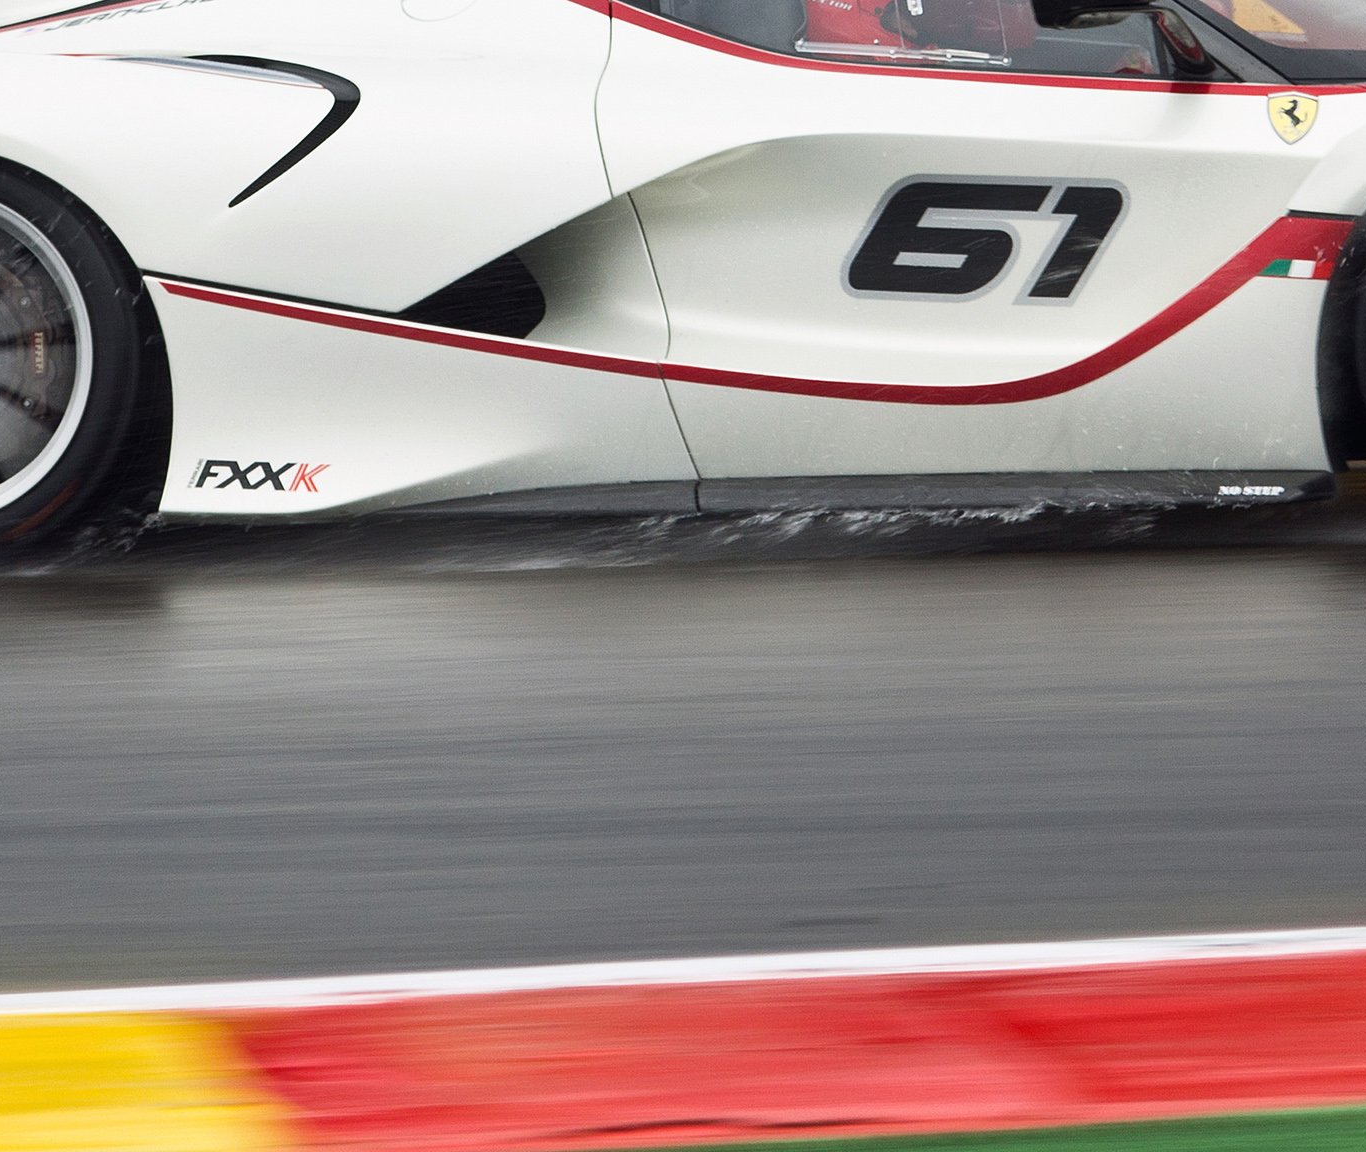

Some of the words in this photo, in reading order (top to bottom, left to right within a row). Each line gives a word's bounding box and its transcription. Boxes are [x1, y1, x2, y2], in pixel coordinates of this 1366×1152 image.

[841, 174, 1131, 307] 61
[1218, 485, 1243, 497] NO
[1242, 485, 1286, 497] STEP
